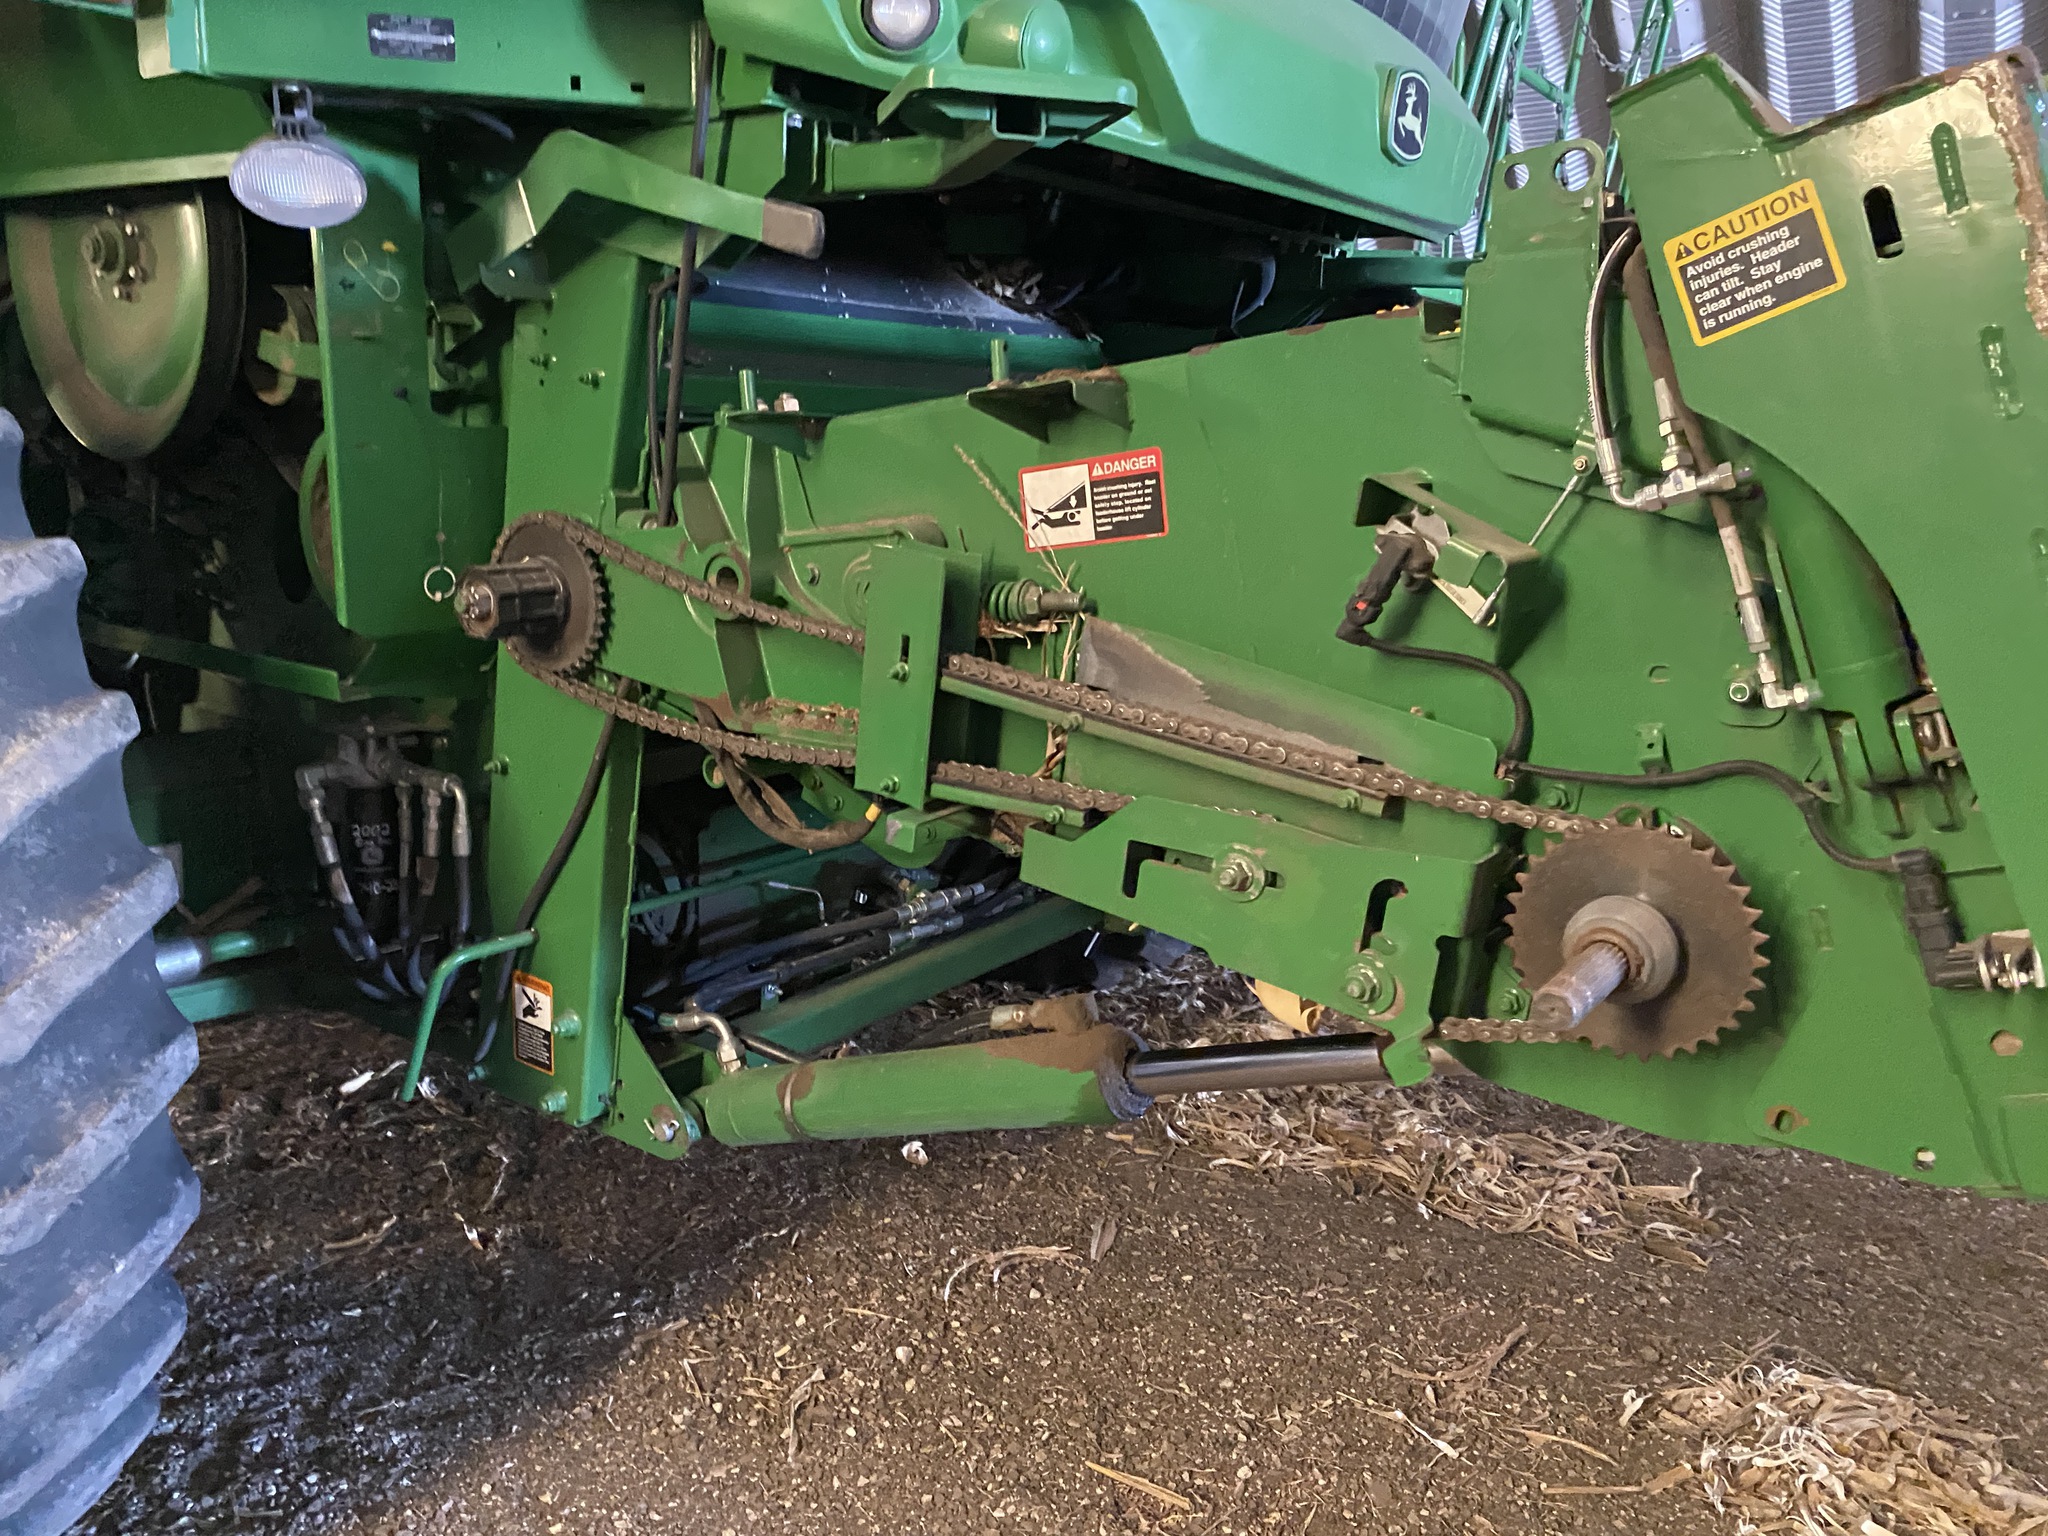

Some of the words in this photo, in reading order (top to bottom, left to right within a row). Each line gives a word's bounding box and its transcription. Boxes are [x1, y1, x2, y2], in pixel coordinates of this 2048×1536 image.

[1693, 186, 1810, 251] CAUTION
[1686, 253, 1726, 278] Avoid
[1727, 226, 1790, 260] crushing
[1689, 262, 1745, 291] injuries.
[1750, 235, 1800, 265] Header
[1694, 288, 1720, 303] can
[1722, 275, 1745, 294] tilt.
[1750, 259, 1782, 280] Stay
[1699, 297, 1732, 317] clear
[1734, 279, 1773, 301] when
[1775, 257, 1824, 284] engine
[1703, 318, 1716, 330] is
[1718, 294, 1777, 323] running.
[1103, 455, 1157, 475] DANGER
[1119, 490, 1136, 498] ground
